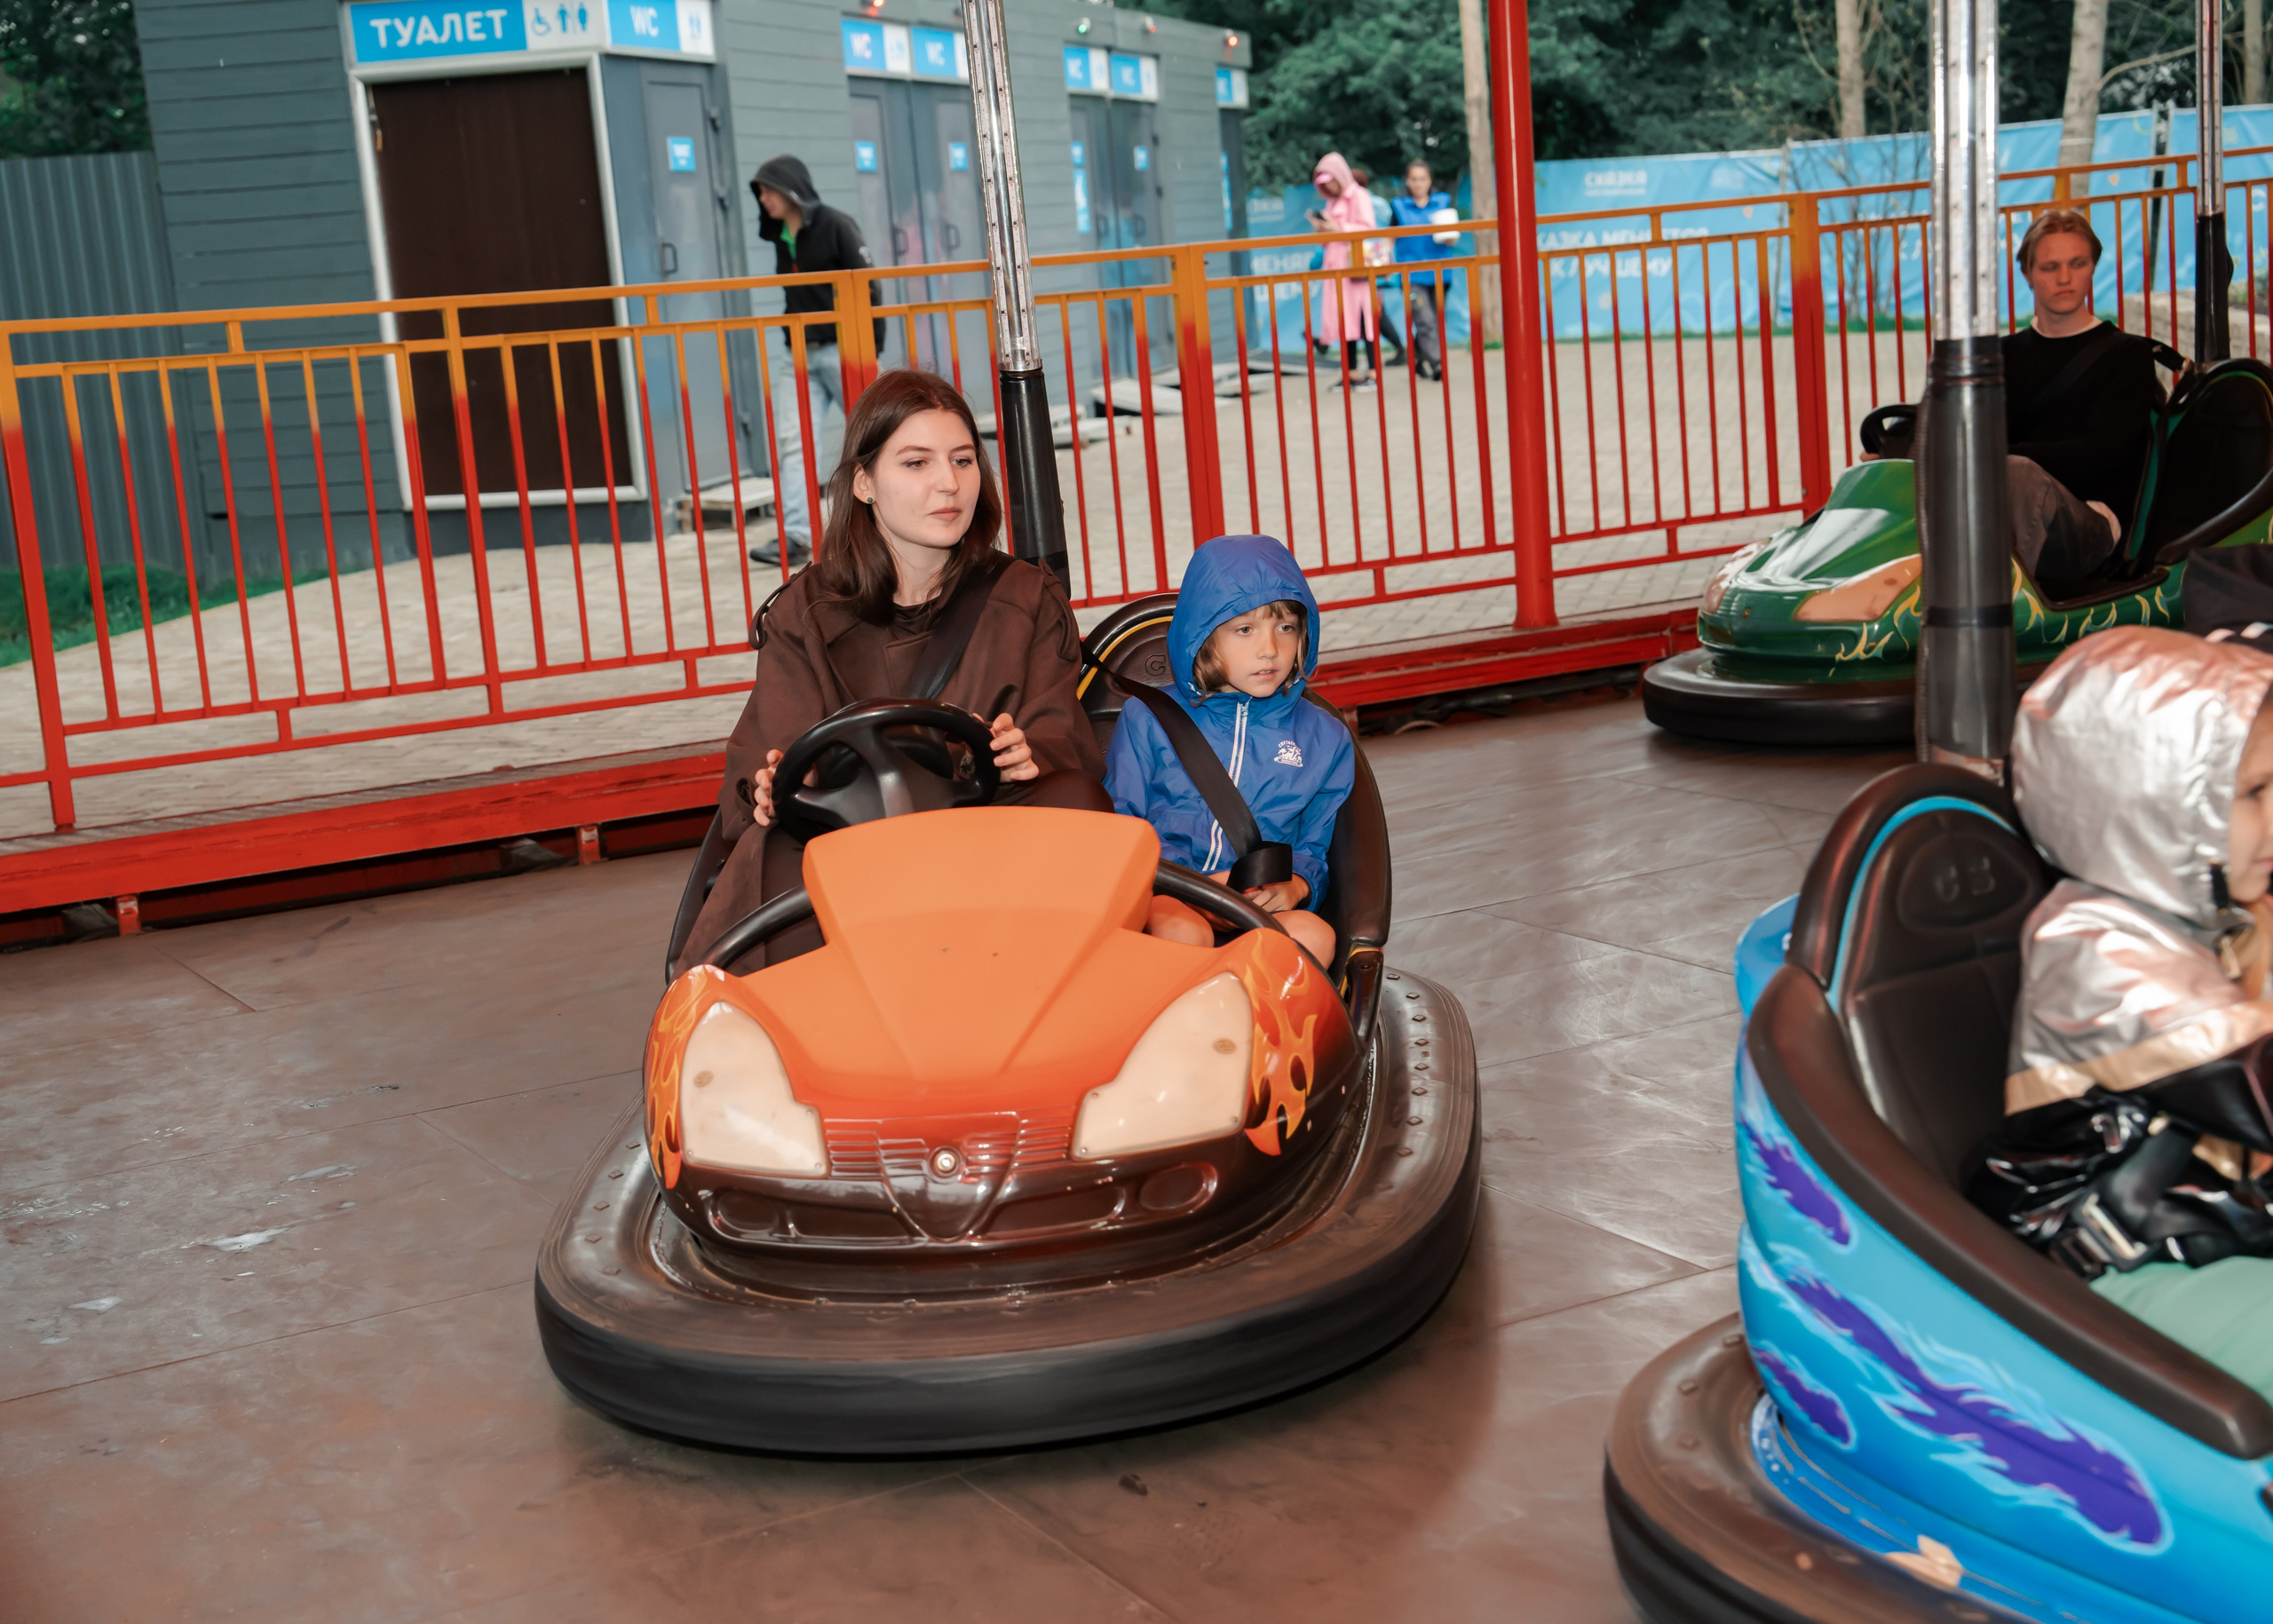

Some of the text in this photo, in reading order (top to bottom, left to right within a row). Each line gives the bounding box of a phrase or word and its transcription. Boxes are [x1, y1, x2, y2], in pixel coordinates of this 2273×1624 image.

[368, 8, 508, 49] ТУАЛЕТ
[629, 6, 659, 37] WC
[1537, 229, 1598, 252] КАЗКА
